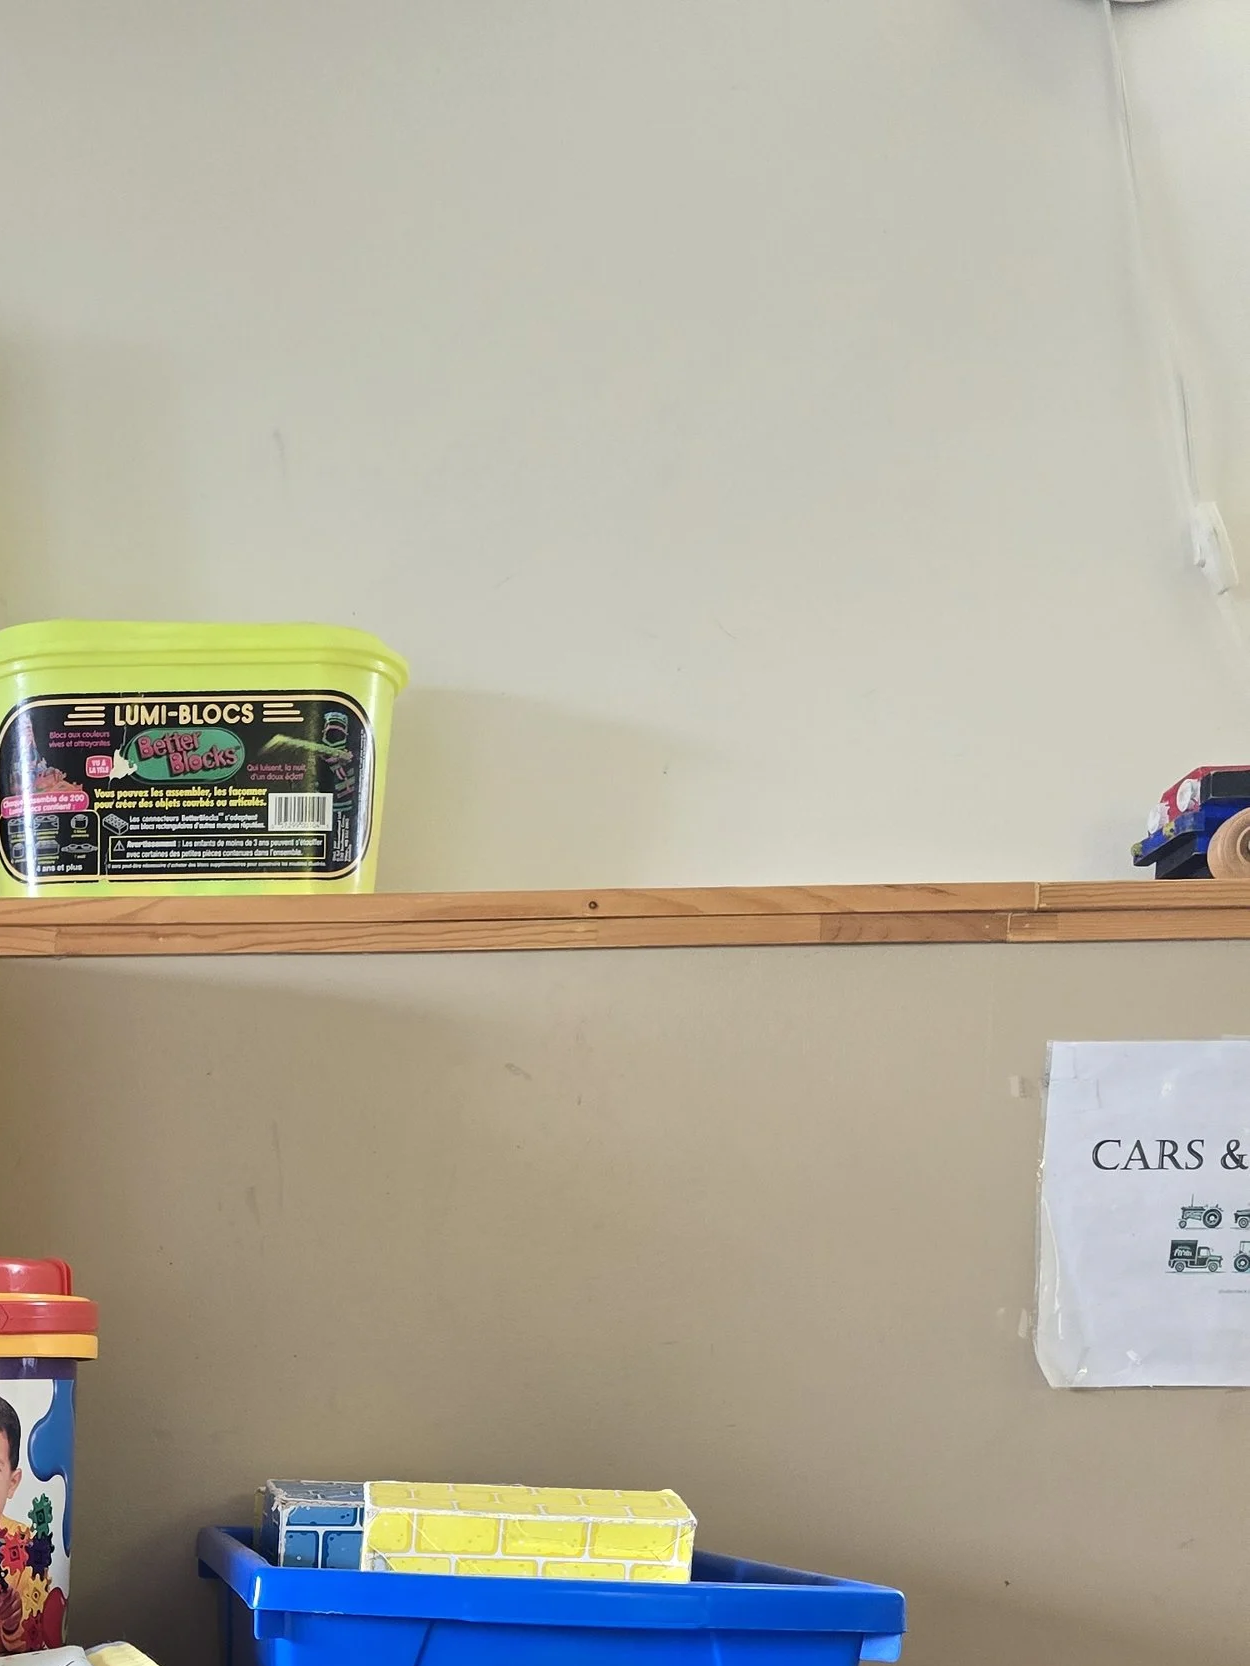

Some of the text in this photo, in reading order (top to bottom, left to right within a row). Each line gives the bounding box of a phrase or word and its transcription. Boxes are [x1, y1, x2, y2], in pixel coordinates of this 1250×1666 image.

[114, 703, 255, 727] LUMI-BLOCS
[82, 730, 110, 739] couleurs
[137, 731, 201, 760] Better
[169, 746, 239, 777] Blocks
[246, 764, 259, 772] Qui
[266, 772, 284, 780] doux
[58, 794, 69, 802] de
[69, 794, 85, 803] 200
[94, 788, 115, 799] Vous
[117, 789, 149, 801] pouvez
[150, 787, 164, 797] les
[165, 786, 213, 799] assembler,
[213, 786, 228, 796] les
[94, 800, 115, 812] pour
[115, 799, 137, 809] créer
[138, 797, 154, 809] des
[155, 797, 181, 811] objets
[182, 796, 215, 808] courbés
[228, 796, 268, 807] articulés.
[244, 839, 252, 847] de
[56, 863, 65, 872] et
[65, 863, 83, 873] plus
[1091, 1139, 1250, 1171] CARS &
